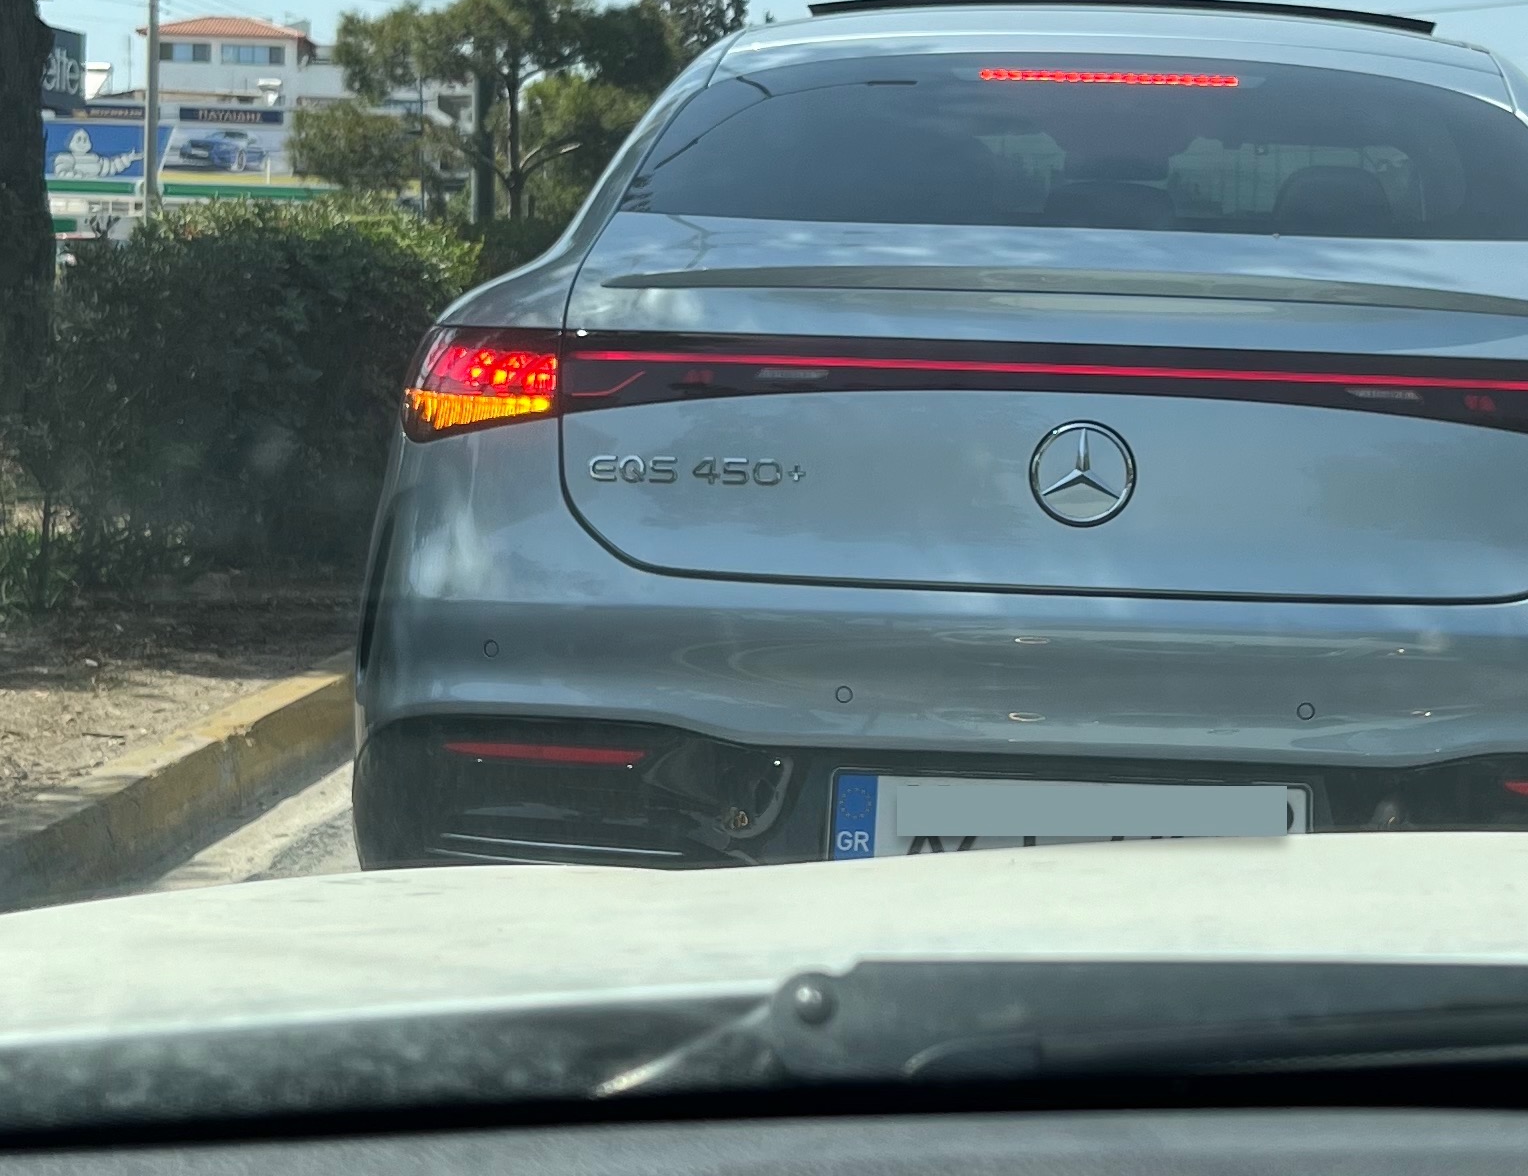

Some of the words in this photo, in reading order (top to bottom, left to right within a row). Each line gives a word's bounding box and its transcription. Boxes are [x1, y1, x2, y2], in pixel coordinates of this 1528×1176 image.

[589, 455, 678, 484] EQS
[692, 456, 806, 486] 450+
[836, 830, 870, 853] GR
